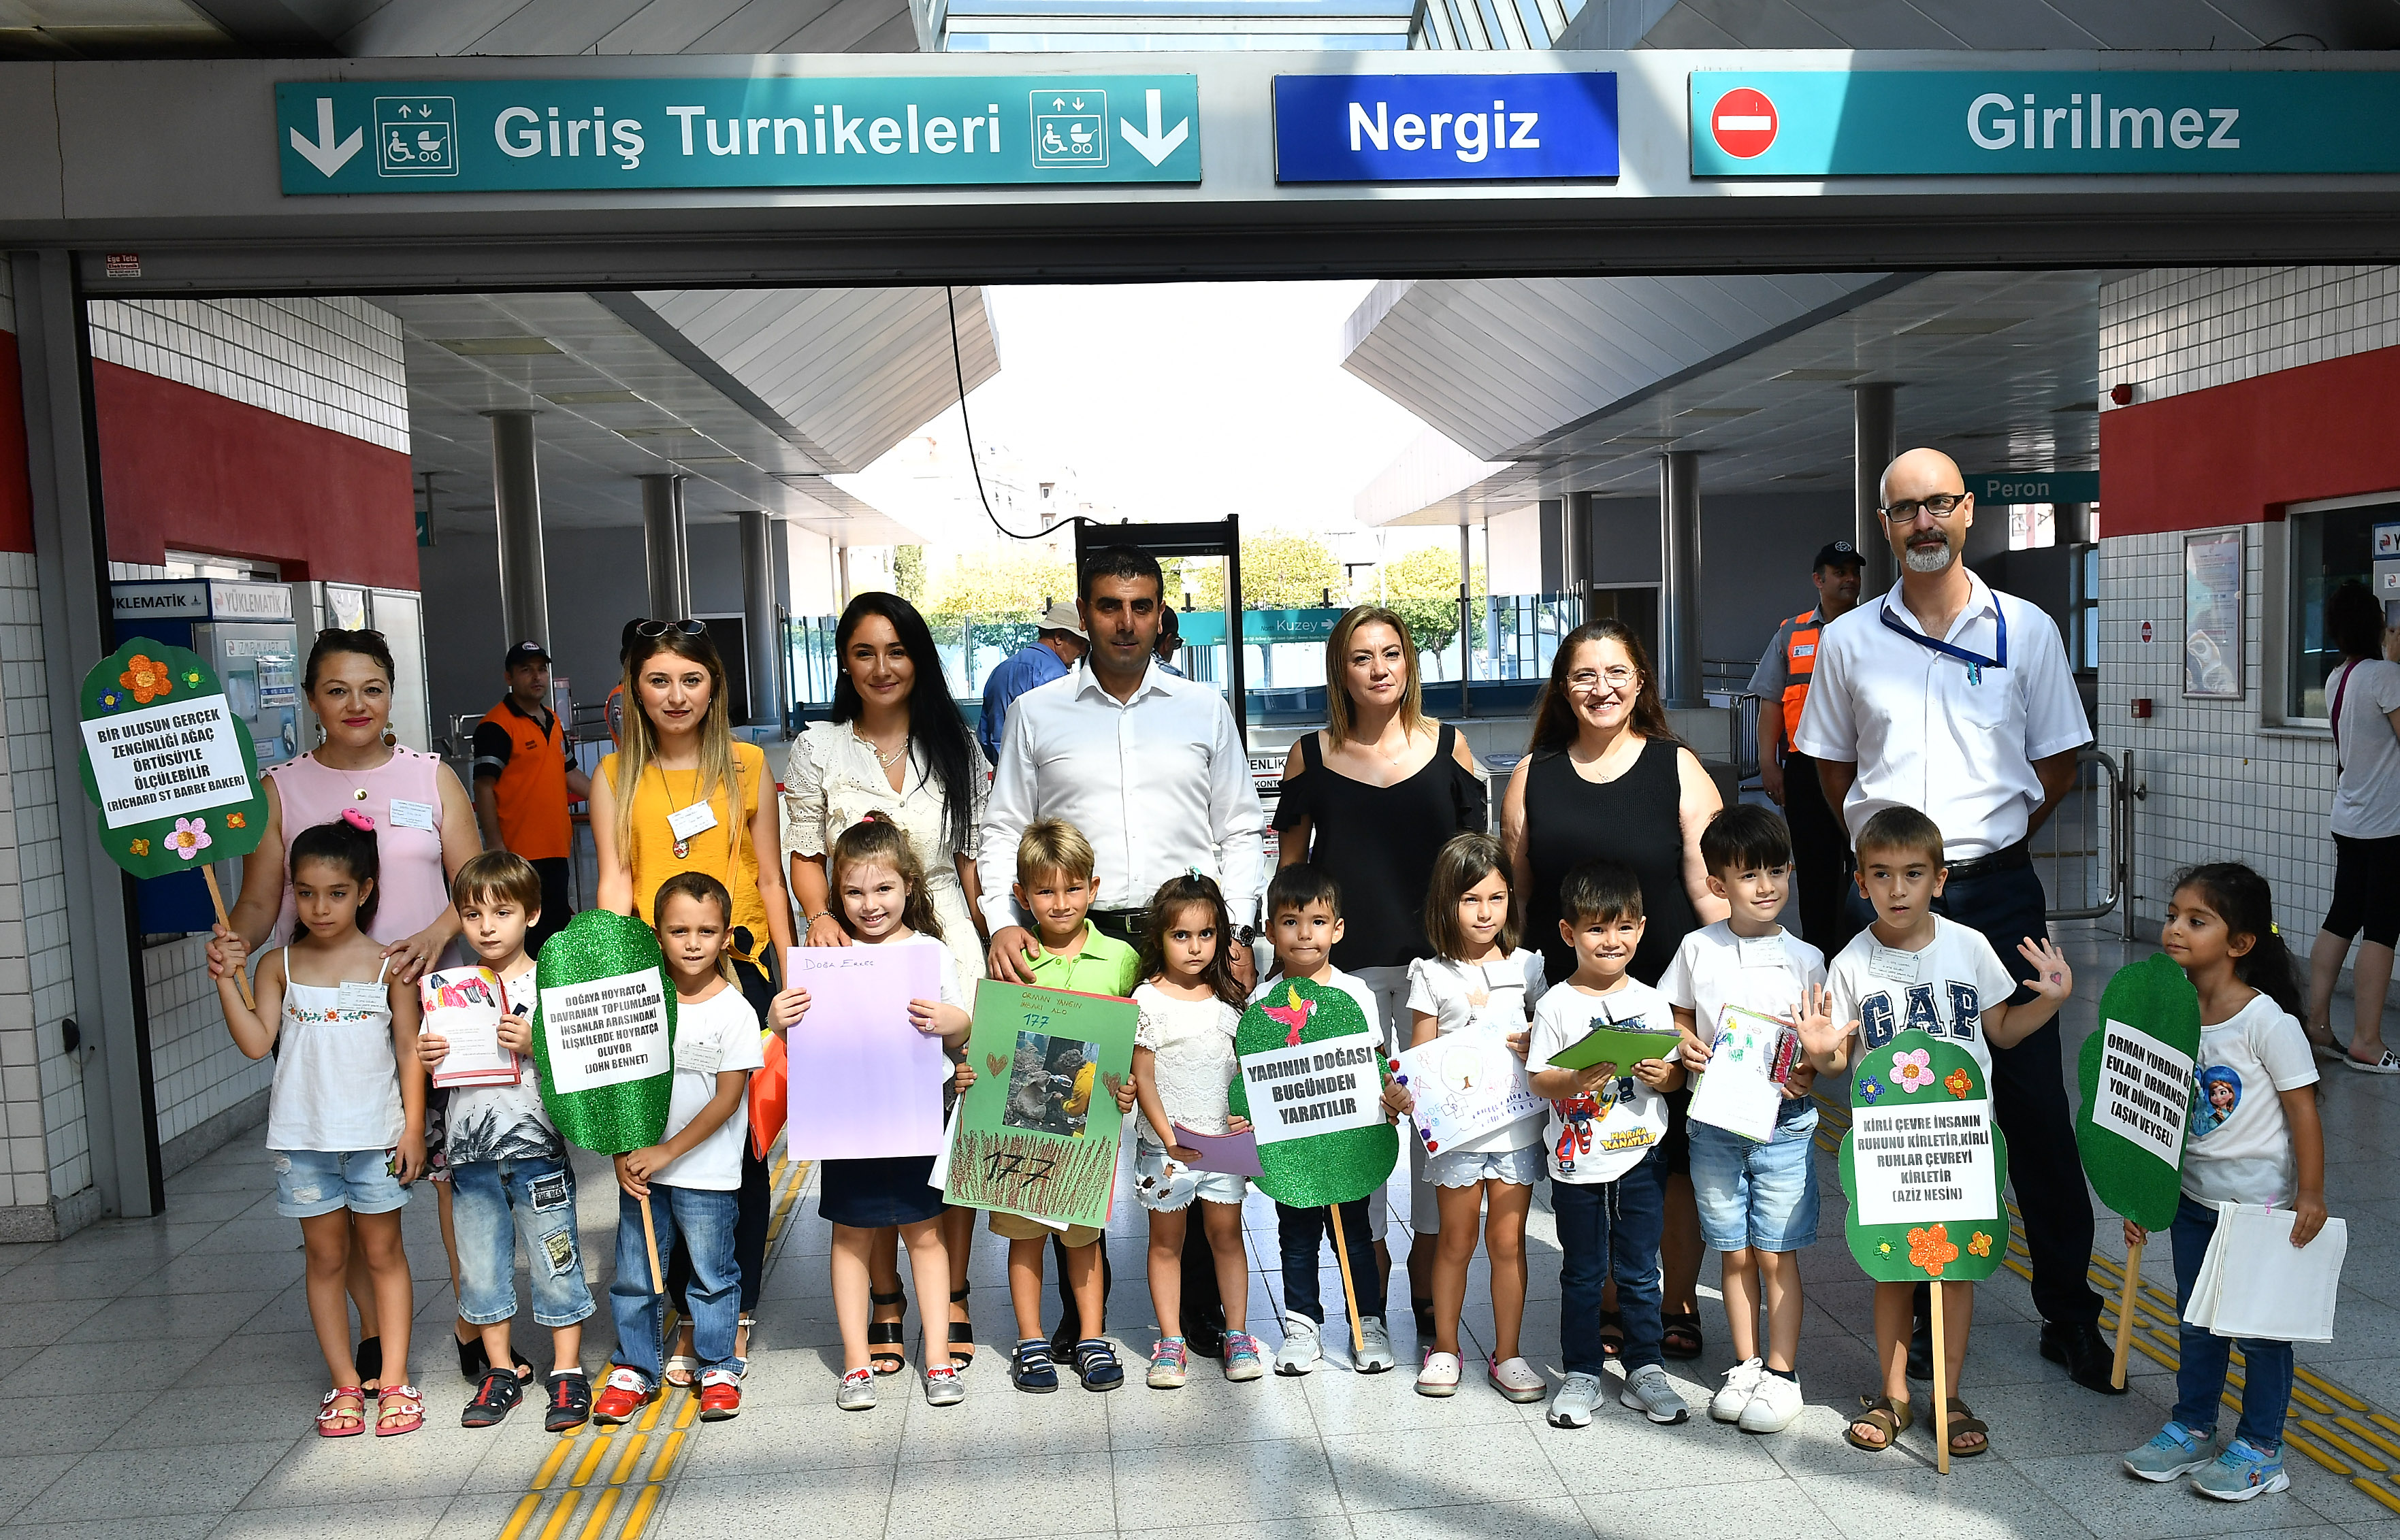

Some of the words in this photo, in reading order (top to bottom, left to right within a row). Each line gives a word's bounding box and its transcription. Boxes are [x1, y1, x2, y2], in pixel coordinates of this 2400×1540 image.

[1348, 99, 1540, 163] Nergiz
[1966, 93, 2241, 150] Girilmez
[493, 105, 645, 170] Giriş
[666, 103, 1001, 157] Turnikeleri
[107, 255, 120, 263] Ege
[1987, 480, 2050, 498] Peron
[225, 588, 282, 613] YÜKLEMATİK
[1277, 619, 1318, 632] Kuzey
[97, 727, 120, 743] BİR
[121, 718, 171, 738] ULUSUN
[172, 708, 221, 728] GERÇEK
[112, 732, 178, 759] ZENGİNLİĞİ
[181, 727, 214, 744] AĞAÇ
[133, 748, 203, 772] ÖRTÜSÜYLE
[1248, 757, 1285, 770] ENLİK
[134, 764, 210, 791] ÖLÇÜLEBİLİR
[1254, 780, 1279, 788] KONT
[108, 791, 157, 813] (RİCHARD
[159, 790, 172, 802] ST
[174, 783, 207, 798] BARBE
[208, 775, 245, 792] BAKER)
[566, 992, 600, 1006] DOĞAYA
[602, 983, 647, 1000] HOYRATÇA
[1022, 992, 1051, 1003] ORMAN
[1056, 998, 1082, 1009] YANGIN
[550, 1006, 598, 1023] DAVRANAN
[602, 994, 661, 1014] TOPLUMLARDA
[560, 1019, 604, 1036] İNSANLAR
[606, 1007, 657, 1028] ARASINDAKİ
[1023, 1013, 1050, 1028] 177
[1858, 979, 1980, 1050] GAP
[562, 1032, 615, 1049] İLİŞKİLERDE
[616, 1022, 659, 1040] HOYRATÇA
[598, 1043, 632, 1057] OLUYOR
[2107, 1034, 2145, 1062] ORMAN
[2146, 1050, 2183, 1083] YURDUN
[2183, 1070, 2191, 1091] ÖZ
[585, 1060, 610, 1074] (JOHN
[612, 1054, 649, 1069] BENNET)
[1247, 1057, 1311, 1083] YARININ
[1313, 1047, 1373, 1072] DOĞASI
[1272, 1073, 1357, 1102] BUGÜNDEN
[2106, 1054, 2142, 1083] EVLADI
[2144, 1072, 2187, 1112] ORMANSIZ
[1279, 1098, 1357, 1125] YARATILIR
[2110, 1077, 2130, 1100] YOK
[2131, 1088, 2161, 1118] DÜNYA
[2162, 1104, 2181, 1130] TADI
[1864, 1117, 1892, 1132] KİRLİ
[1895, 1117, 1932, 1132] ÇEVRE
[1934, 1115, 1981, 1128] İNSANIN
[2111, 1101, 2139, 1128] (AŞIK
[2140, 1115, 2173, 1148] VEYSEL)
[1600, 1132, 1656, 1151] KANATLAR
[1858, 1136, 1904, 1151] RUHUNU
[984, 1150, 1055, 1189] 177
[1877, 1153, 1923, 1167] RUHLAR
[1926, 1149, 1973, 1167] ÇEVREYİ
[1901, 1168, 1951, 1184] KİRLETİR
[1893, 1187, 1921, 1202] (AZİZ
[1924, 1186, 1962, 1201] NESİN)
